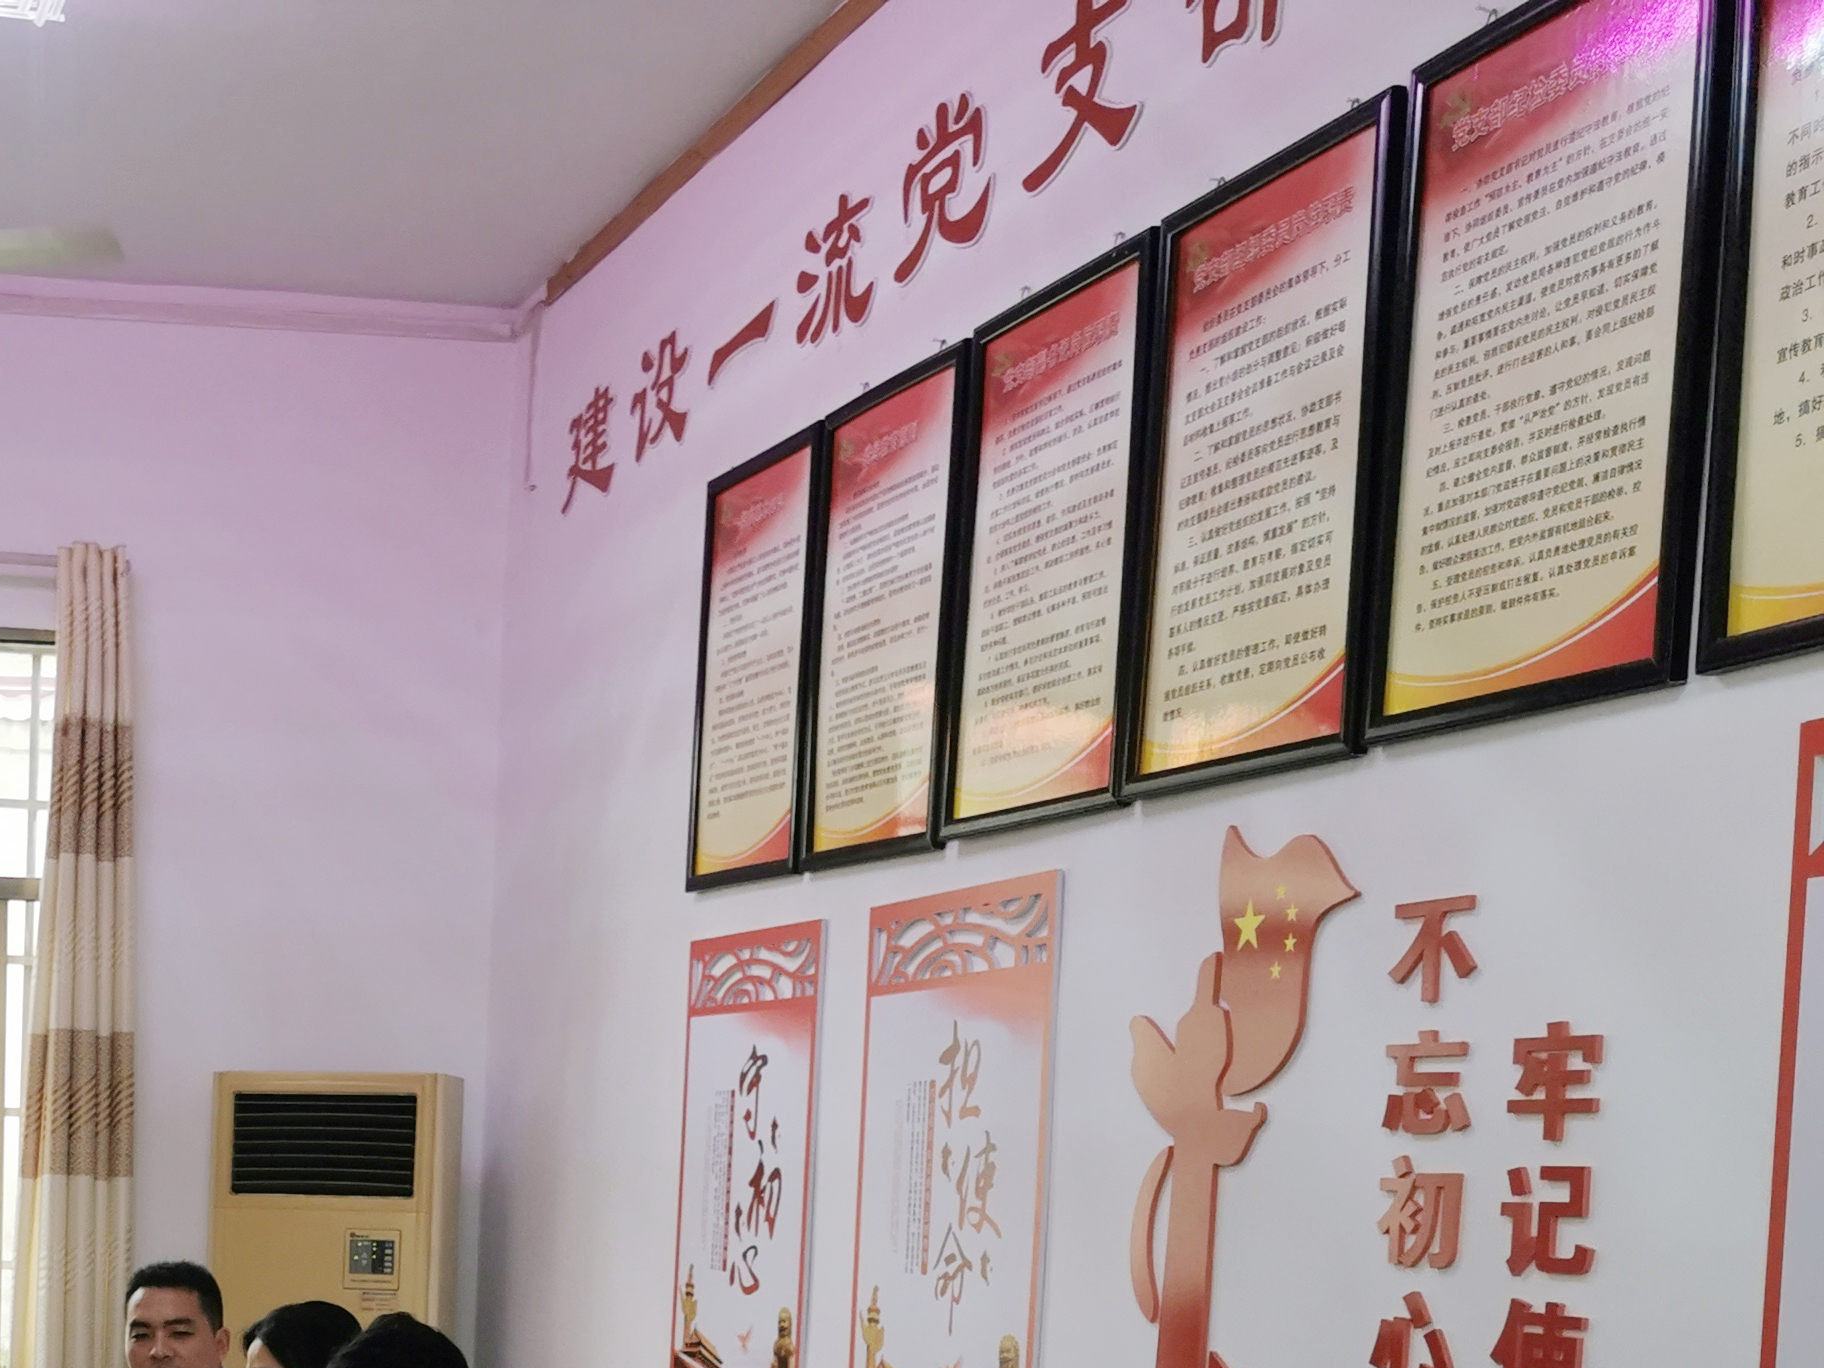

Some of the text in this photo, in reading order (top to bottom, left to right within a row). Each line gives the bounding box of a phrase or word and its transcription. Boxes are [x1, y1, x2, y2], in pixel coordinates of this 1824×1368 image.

[562, 0, 1283, 513] 建设一流党支
[720, 1044, 783, 1296] 守初心
[932, 1019, 1003, 1337] 担使命
